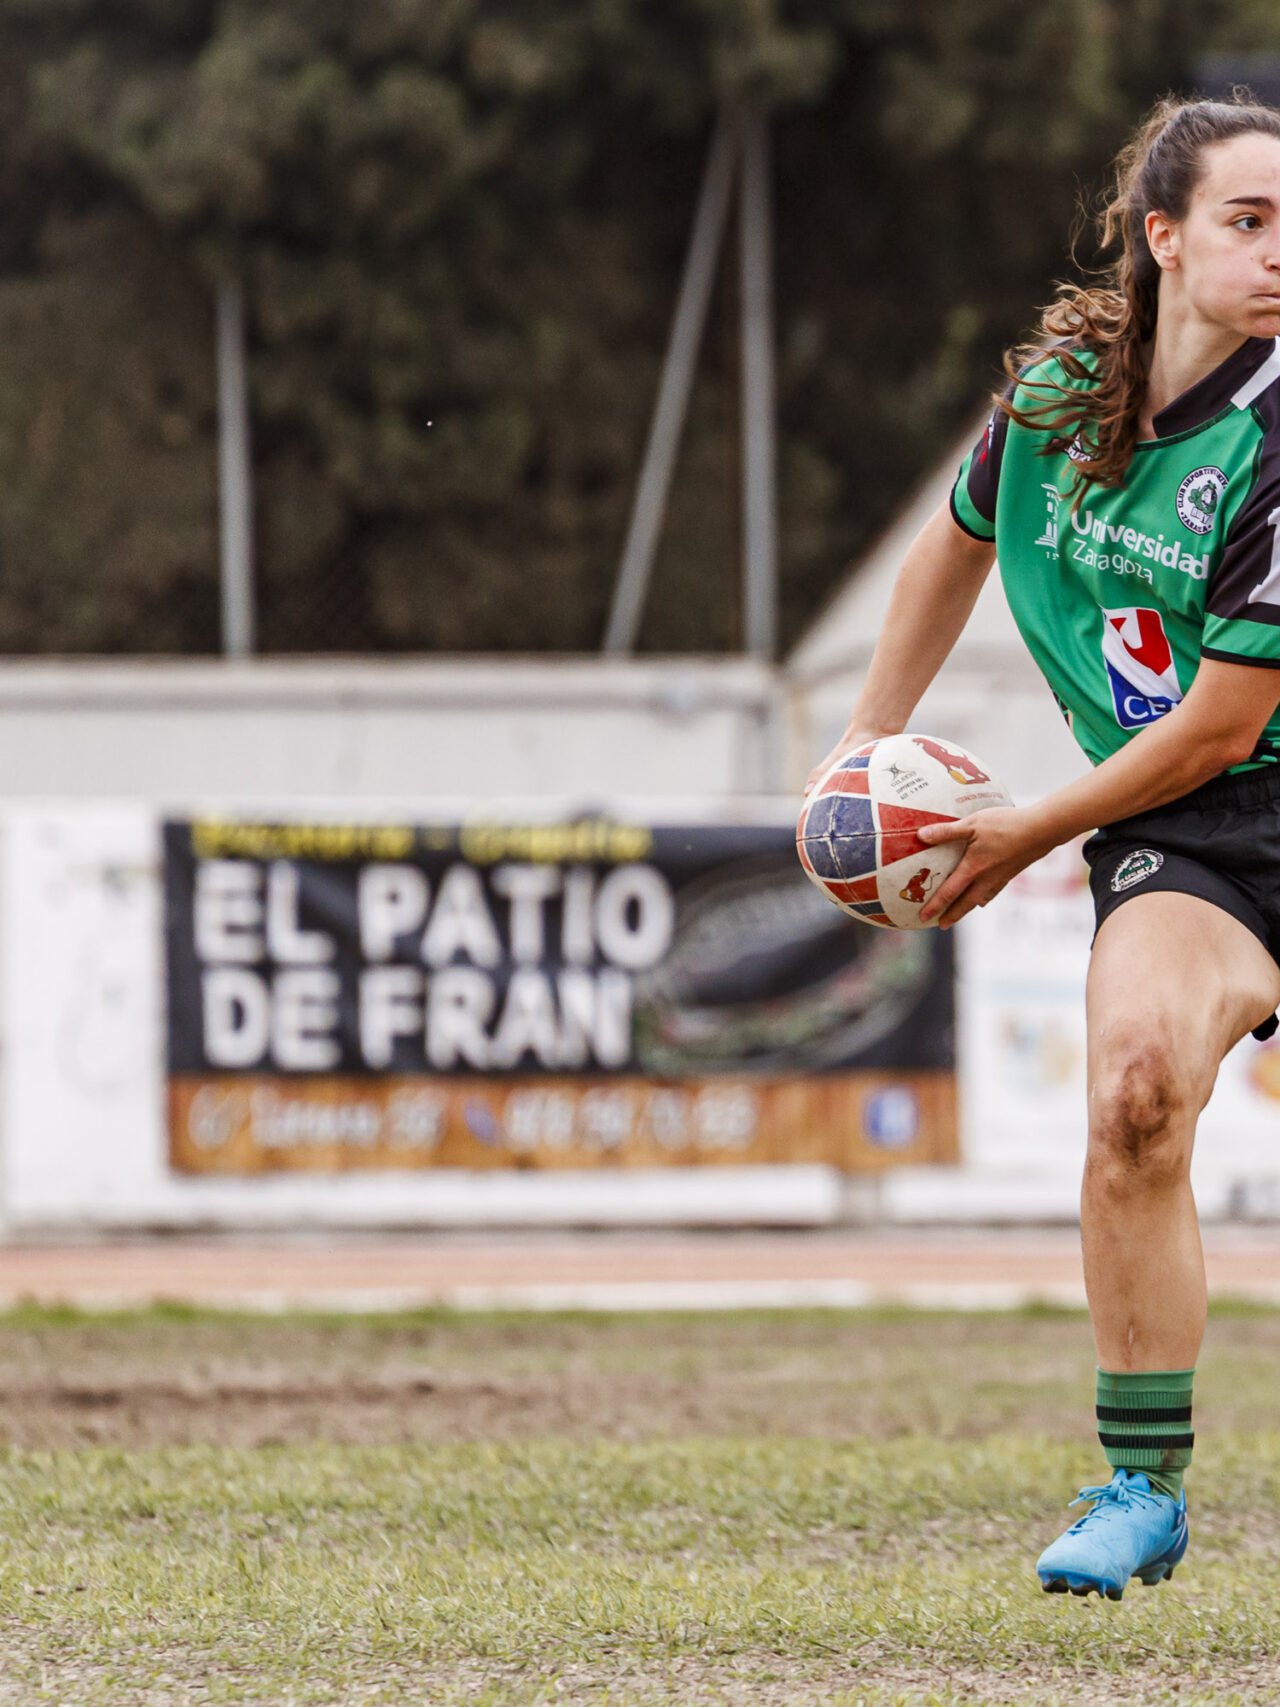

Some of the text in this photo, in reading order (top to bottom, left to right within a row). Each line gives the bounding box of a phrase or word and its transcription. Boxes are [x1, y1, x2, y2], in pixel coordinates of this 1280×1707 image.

[1071, 510, 1210, 580] Universidad
[1072, 538, 1154, 585] Zaragoza
[193, 862, 676, 971] EL PATIO
[203, 967, 635, 1070] DE FRAN
